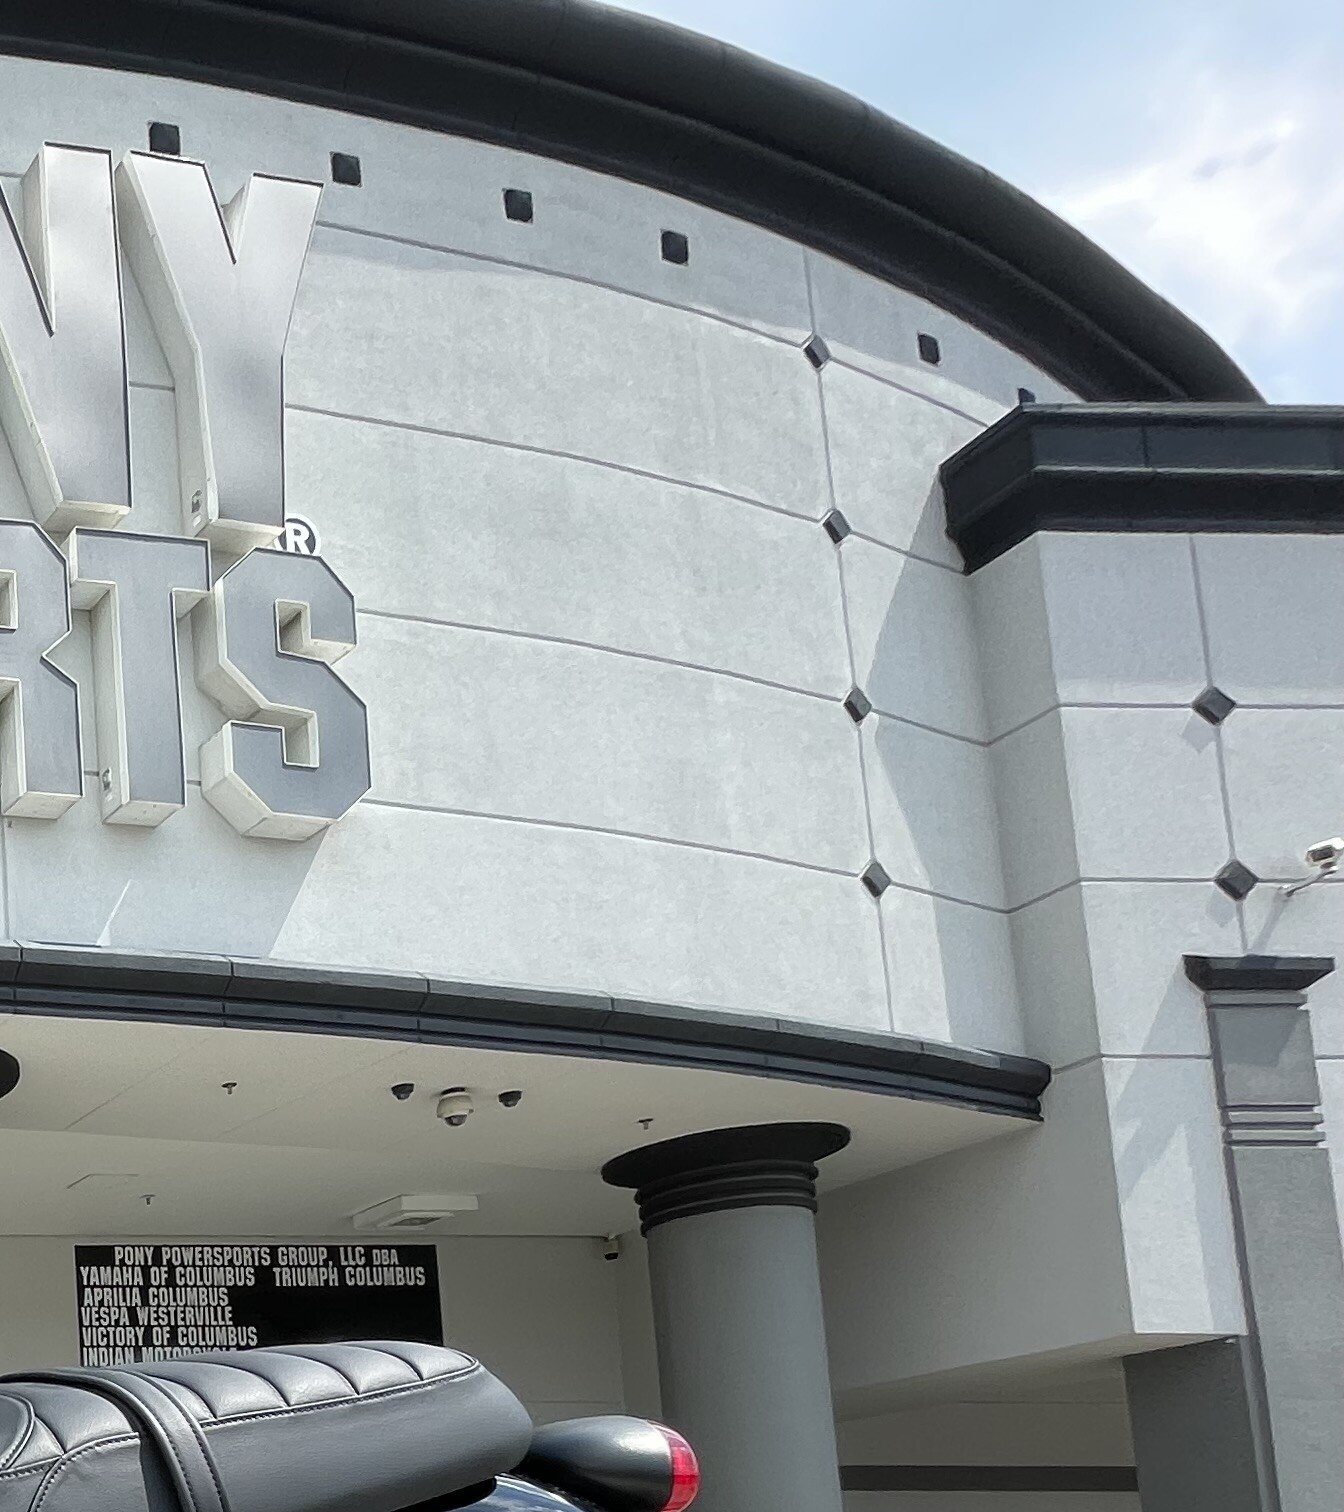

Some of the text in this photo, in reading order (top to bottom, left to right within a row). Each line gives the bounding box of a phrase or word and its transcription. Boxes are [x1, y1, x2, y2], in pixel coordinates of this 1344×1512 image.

[114, 1246, 399, 1267] PONY POWERSPORTS GROUP, LLC DBA
[80, 1266, 255, 1287] YAMAHA OF COLUMBUS
[273, 1266, 426, 1287] TRIUMPH COLUMBUS
[83, 1287, 229, 1307] APRILIA COLUMBUS
[80, 1306, 233, 1326] VESPA WESTERVILLE
[82, 1327, 258, 1346] VICTORY OF COLUMBUS
[82, 1347, 135, 1366] INDIAN
